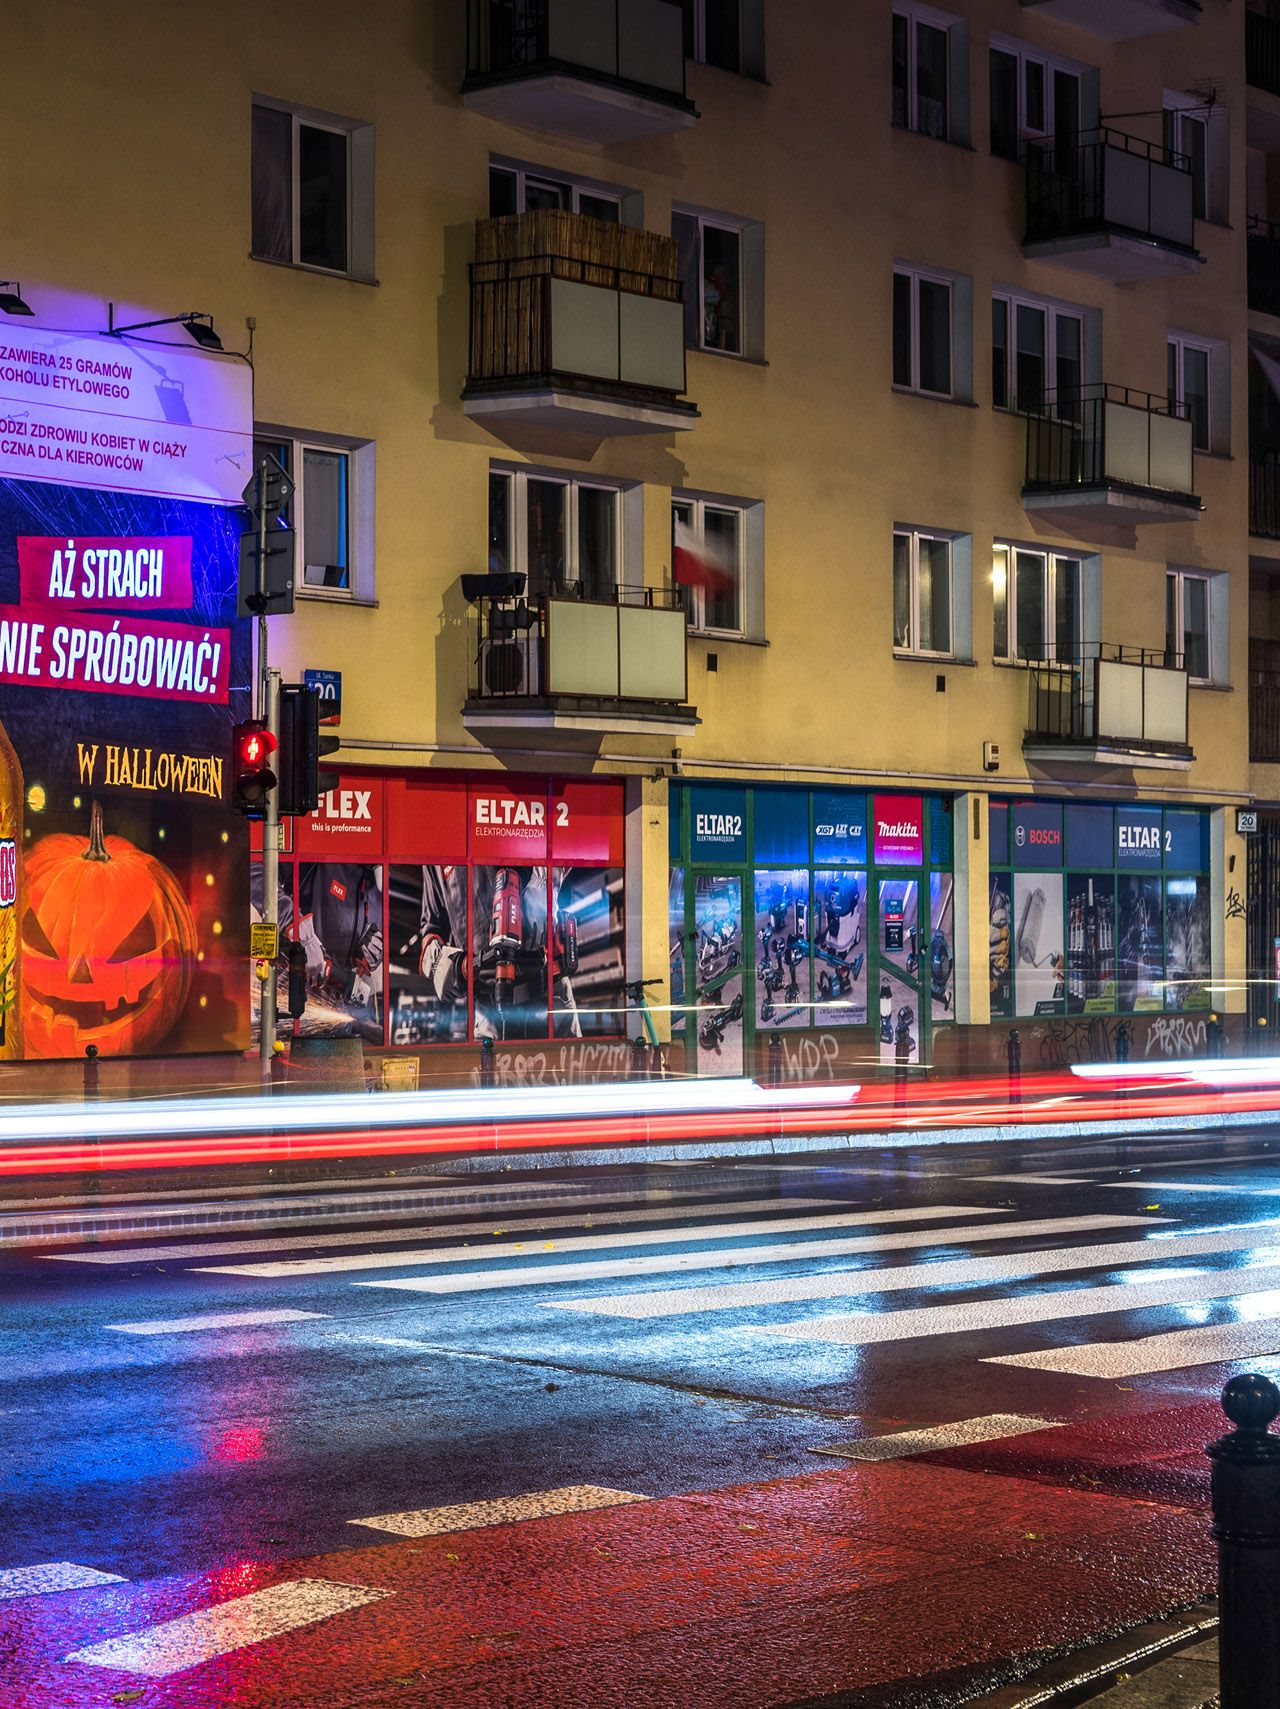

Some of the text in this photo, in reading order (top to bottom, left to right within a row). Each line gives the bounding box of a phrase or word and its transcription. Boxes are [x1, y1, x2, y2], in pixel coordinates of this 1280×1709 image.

[0, 346, 56, 368] ZAWIERA
[59, 356, 73, 371] 25
[75, 357, 133, 380] GRAMÓW
[53, 376, 130, 400] ETYLOWEGO
[30, 423, 87, 445] ZDROWIU
[91, 432, 136, 451] KOBIET
[138, 438, 150, 453] W
[152, 441, 187, 459] CIĄŻY
[38, 445, 63, 461] DLA
[66, 449, 144, 472] KIEROWCÓW
[48, 540, 163, 599] AŻ STRACH
[50, 619, 221, 694] SPRÓBOWAĆ!
[77, 743, 223, 800] W HALLOWEEN
[476, 798, 569, 827] ELTAR 2
[696, 814, 742, 836] ELTAR2
[1241, 816, 1254, 826] 20
[312, 822, 372, 834] this is proformance
[475, 827, 545, 839] ELEKTRONARZĘDZIA
[1029, 829, 1061, 844] BOSCH
[1118, 826, 1172, 852] ELTAR 2
